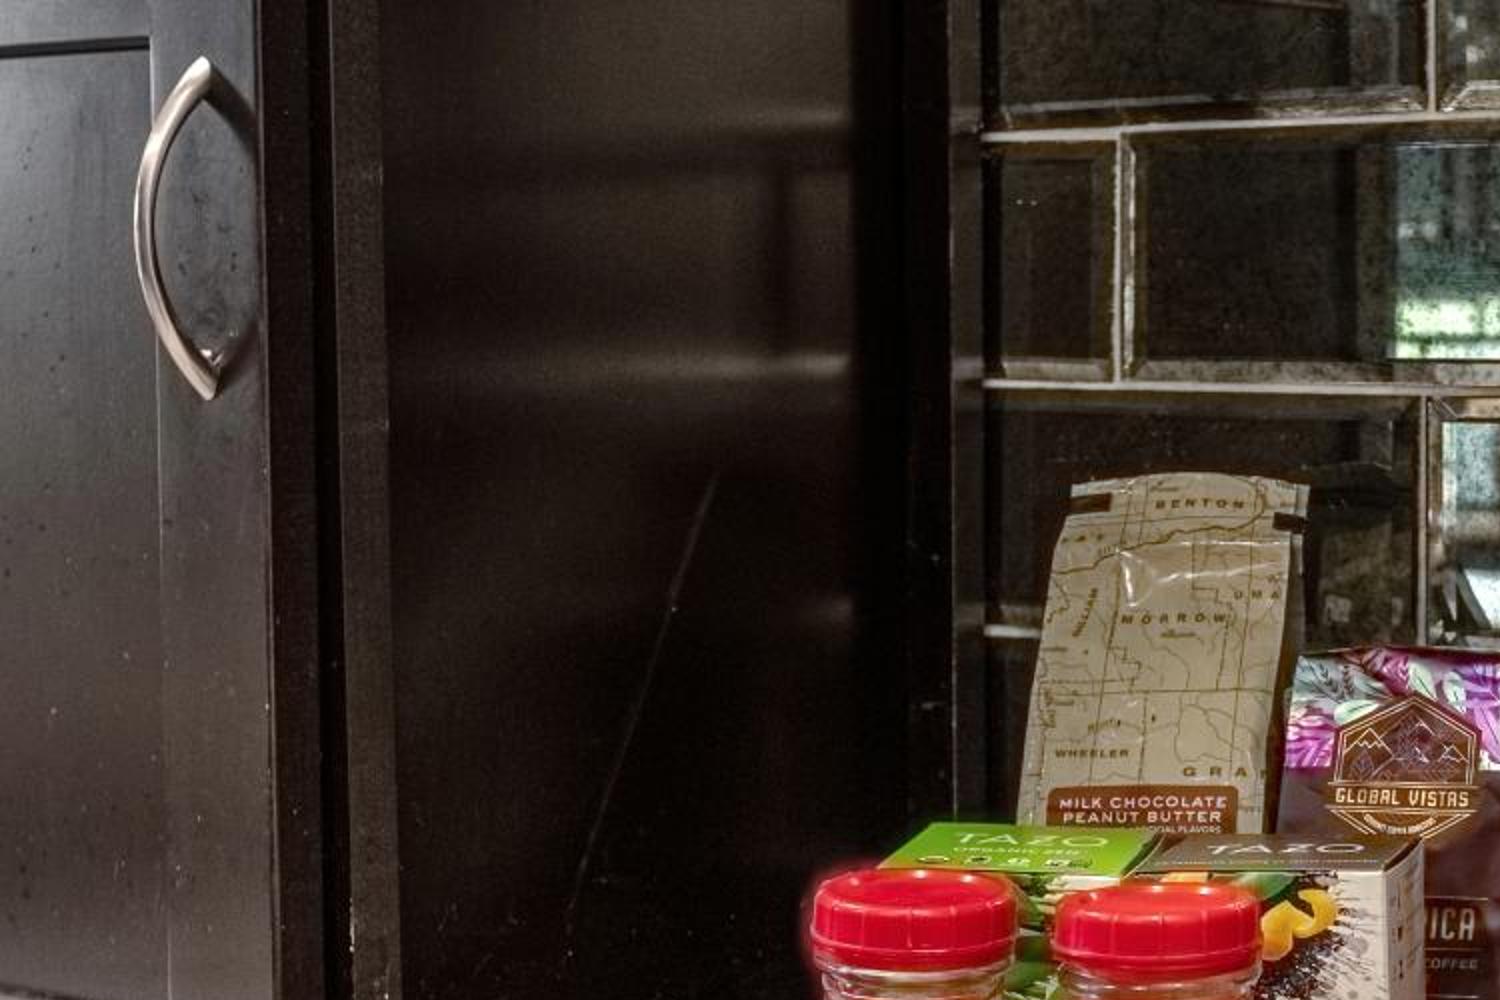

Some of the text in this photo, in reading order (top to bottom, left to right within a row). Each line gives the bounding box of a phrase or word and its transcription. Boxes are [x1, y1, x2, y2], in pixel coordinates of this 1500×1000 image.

[1154, 497, 1246, 510] BENTON
[1120, 611, 1227, 625] MORROW
[1054, 748, 1129, 759] WHEELER
[1058, 795, 1228, 810] MILK CHOCOLATE
[1334, 786, 1470, 808] GLOBAL VISTAS
[1062, 810, 1222, 824] PEANUT BUTTER
[955, 831, 1110, 848] TAZO
[1206, 842, 1366, 856] TAZO
[1425, 905, 1477, 942] ICA
